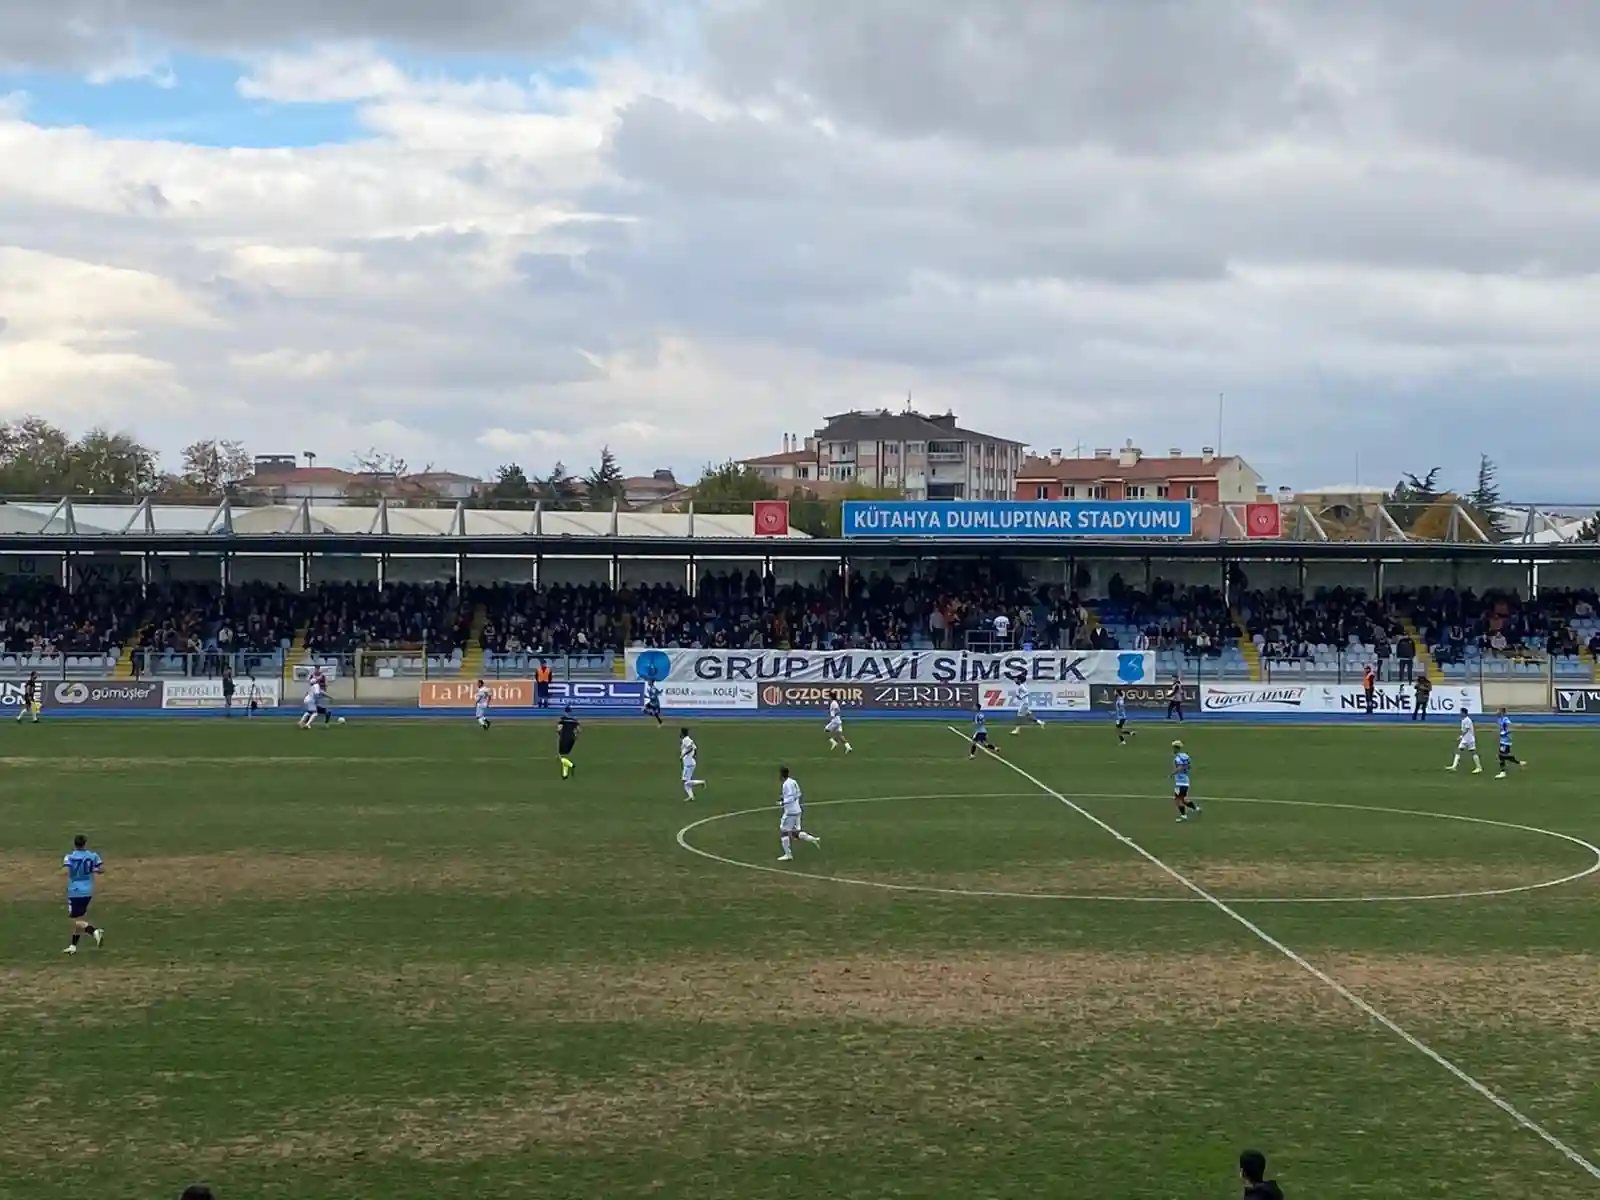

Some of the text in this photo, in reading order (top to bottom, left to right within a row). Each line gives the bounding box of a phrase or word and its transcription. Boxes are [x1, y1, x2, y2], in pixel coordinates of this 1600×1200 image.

[854, 504, 1181, 529] KÜTAHYA DUMLUPINAR STADYUMU
[694, 655, 809, 680] GRUP
[822, 651, 920, 681] MAVİ
[92, 687, 150, 701] gümüşler
[431, 684, 452, 700] La
[874, 686, 973, 701] ZERDE
[71, 857, 93, 875] 70
